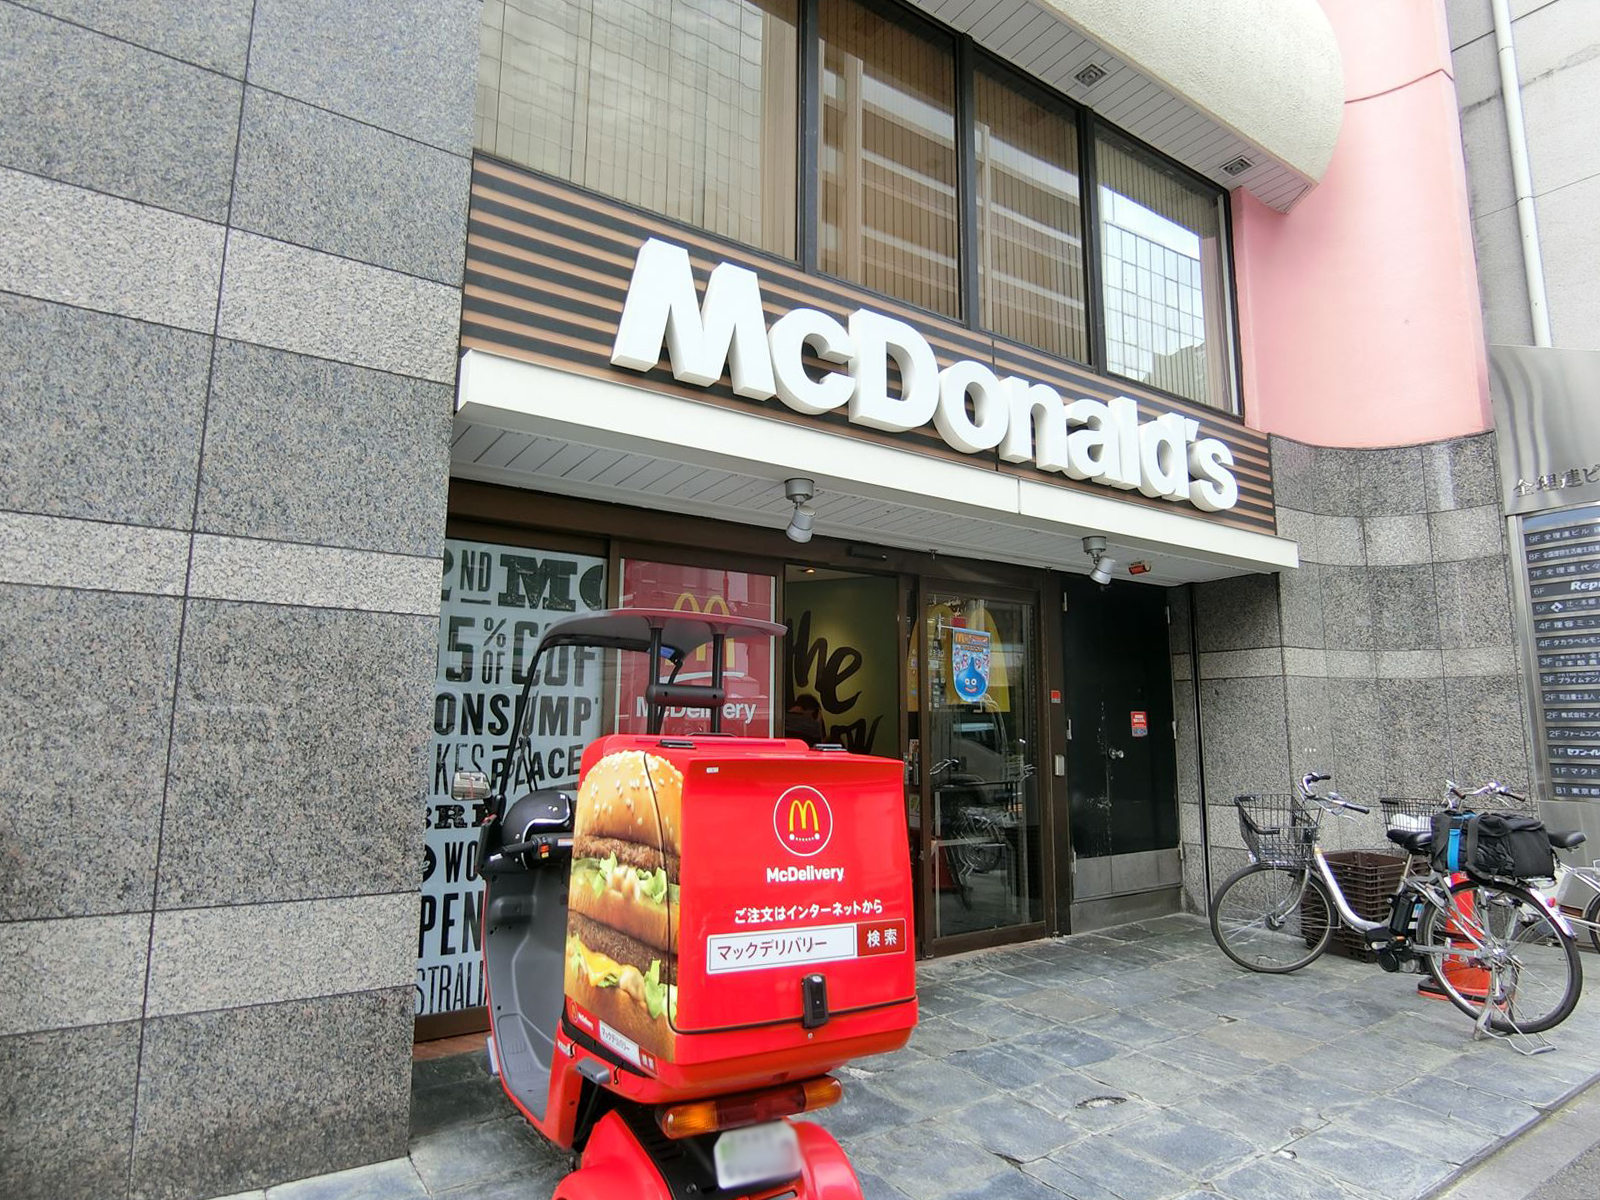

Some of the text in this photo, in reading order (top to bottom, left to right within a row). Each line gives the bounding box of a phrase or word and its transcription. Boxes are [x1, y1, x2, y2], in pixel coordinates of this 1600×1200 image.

[610, 237, 1239, 513] McDonald's
[1529, 535, 1541, 543] 9F
[1528, 553, 1540, 561] 8F
[1531, 570, 1542, 578] 7F
[1534, 581, 1600, 596] 6F Rep
[1539, 621, 1551, 629] 4F
[766, 865, 844, 883] McDelivery
[734, 899, 883, 924] ご注文はインターネットから
[717, 928, 898, 961] マックデリバリー 検索
